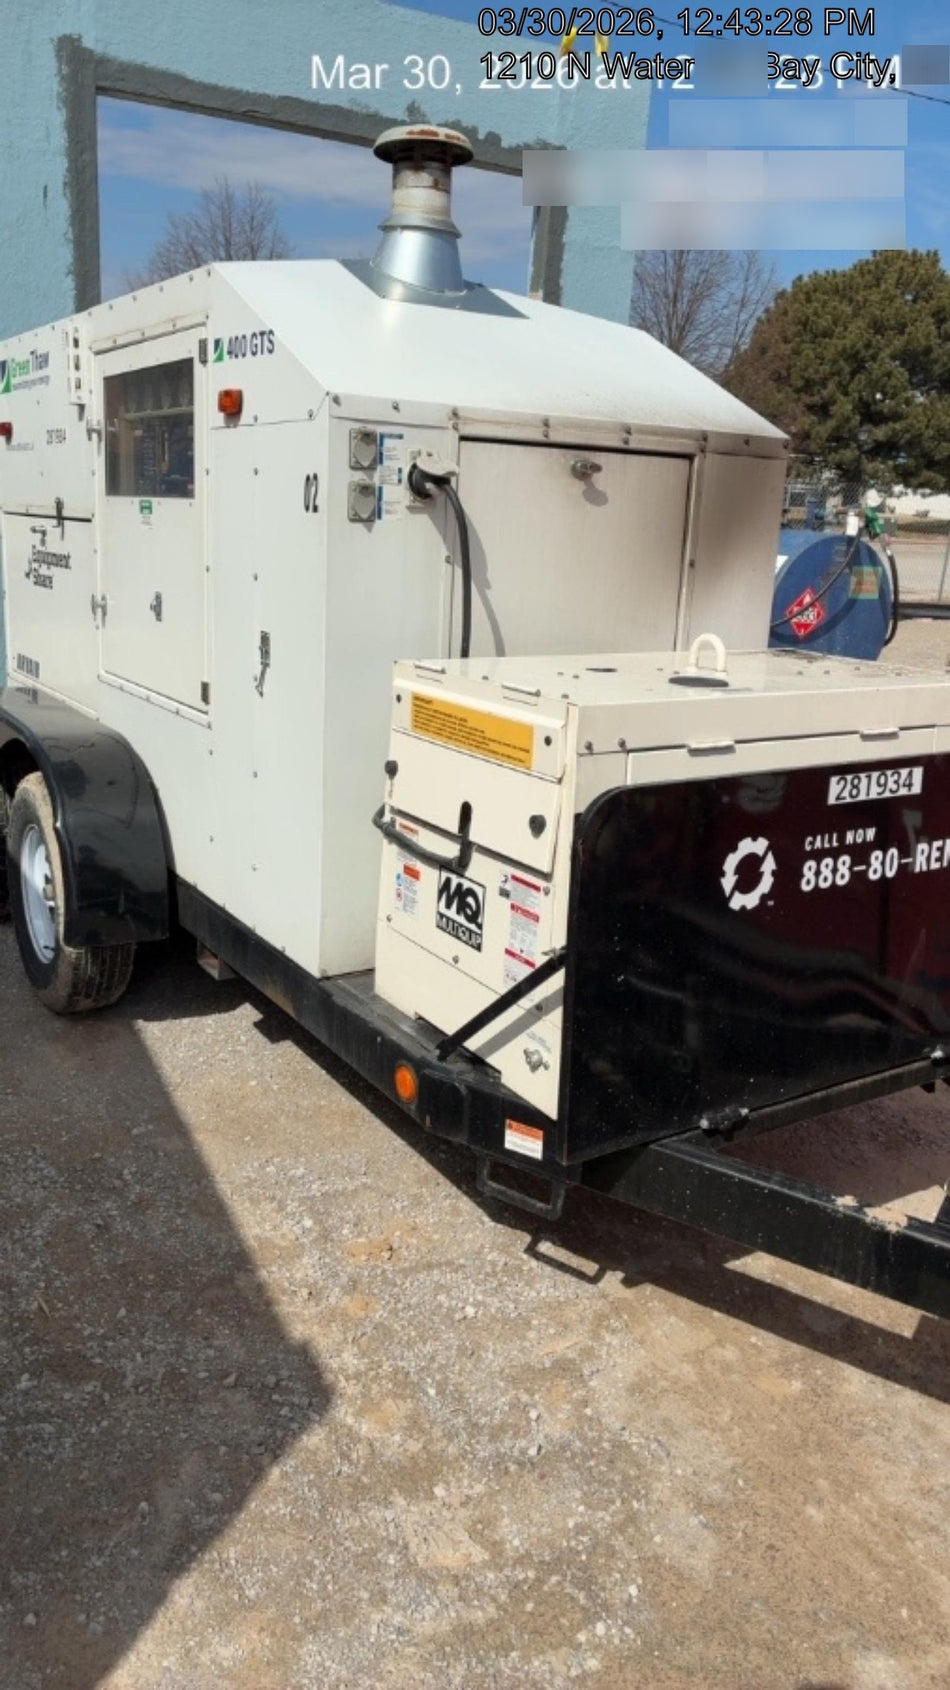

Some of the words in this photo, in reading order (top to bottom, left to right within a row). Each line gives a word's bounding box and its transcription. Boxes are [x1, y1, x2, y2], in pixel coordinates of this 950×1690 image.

[227, 334, 248, 360] 400
[250, 329, 275, 357] GTS
[835, 769, 914, 802] 281934
[804, 833, 839, 851] CALL
[845, 827, 876, 846] NOW
[437, 875, 482, 930] MQ
